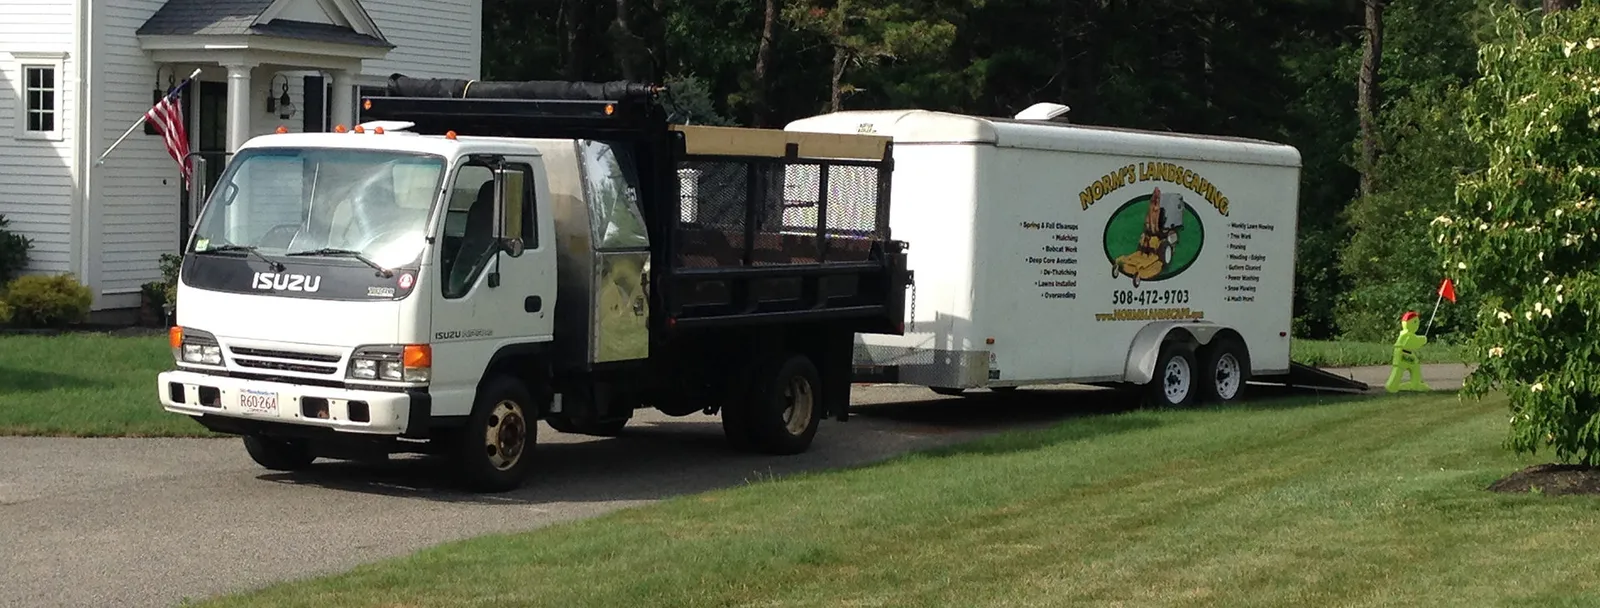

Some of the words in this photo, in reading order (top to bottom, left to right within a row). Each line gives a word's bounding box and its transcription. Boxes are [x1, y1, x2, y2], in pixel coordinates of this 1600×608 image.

[1079, 164, 1137, 211] NORM'S
[1023, 221, 1040, 229] Spring
[1056, 222, 1078, 230] Cleanups
[1056, 234, 1078, 242] Mulching
[1043, 269, 1077, 277] De-Thatching
[252, 272, 322, 293] ISUZU
[1112, 289, 1189, 305] 508-472-9703
[435, 331, 461, 340] ISUZU
[240, 394, 276, 410] R60-264
